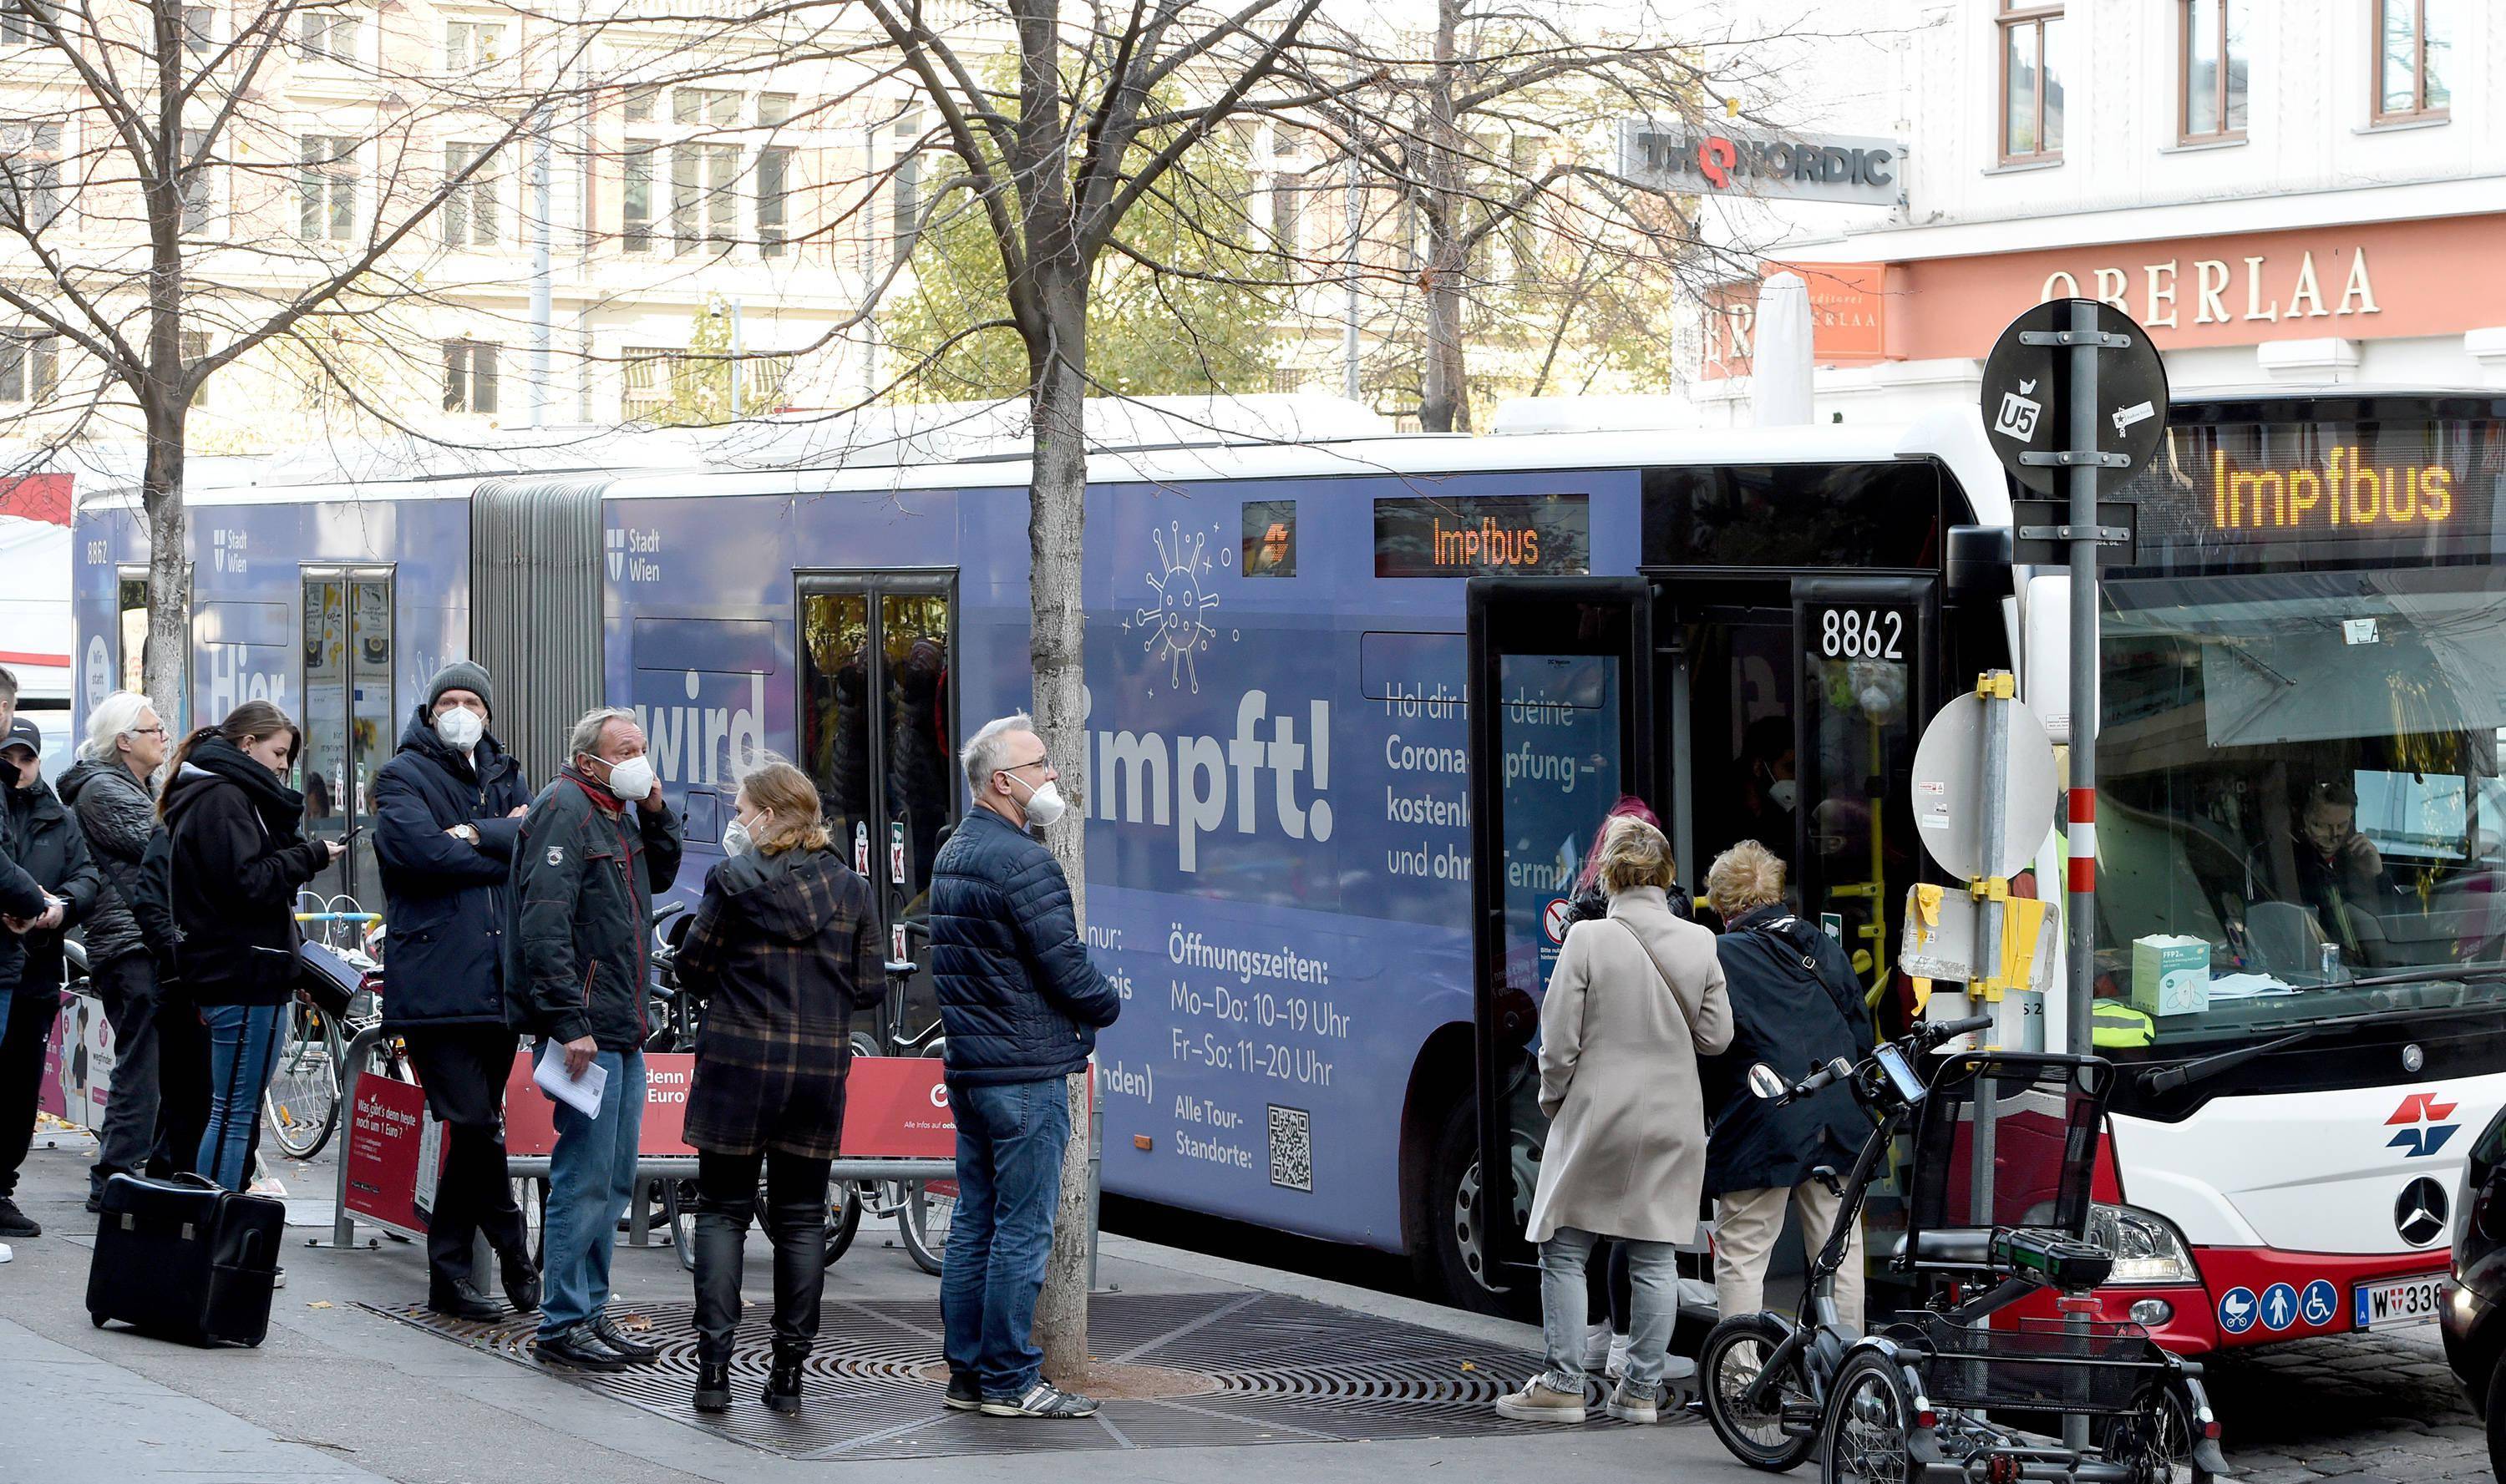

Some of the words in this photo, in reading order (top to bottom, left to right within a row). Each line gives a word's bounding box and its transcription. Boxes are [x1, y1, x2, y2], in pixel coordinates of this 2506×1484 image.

[2001, 398, 2037, 434] U5
[2214, 445, 2452, 529] Impfbus
[88, 540, 108, 565] 8862
[227, 529, 247, 550] Stadt
[629, 528, 660, 553] Stadt
[1433, 516, 1540, 566] Impfbus
[227, 553, 247, 574] Wien
[629, 557, 660, 582] Wien
[1822, 609, 1904, 660] 8862
[1385, 681, 1422, 718] Hol
[1428, 682, 1458, 720] dir
[1510, 686, 1575, 727] deine
[635, 668, 764, 785] wird
[1083, 689, 1333, 874] impft!
[1387, 785, 1470, 828] kostenl
[1387, 841, 1428, 878] und
[1088, 924, 1123, 951] nur:
[1169, 921, 1329, 985] Öffnungszeiten:
[2163, 950, 2179, 959] FFP2
[1108, 966, 1133, 1000] eis
[1312, 1000, 1351, 1038] Uhr
[645, 1069, 684, 1084] denn
[1103, 1060, 1154, 1105] nden)
[1296, 1047, 1334, 1086] Uhr
[356, 1117, 369, 1130] noch
[370, 1121, 379, 1132] um
[381, 1122, 384, 1134] 1
[358, 1098, 369, 1113] Was
[385, 1106, 399, 1122] denn
[399, 1110, 416, 1127] heute
[904, 1121, 916, 1129] Alle
[916, 1121, 931, 1129] Infos
[931, 1121, 941, 1129] auf
[1174, 1094, 1203, 1123] Alle
[1203, 1099, 1244, 1129] Tour-
[1175, 1129, 1253, 1169] Standorte:
[2359, 1310, 2366, 1320] A
[2373, 1289, 2388, 1319] W
[2406, 1282, 2443, 1314] 336
